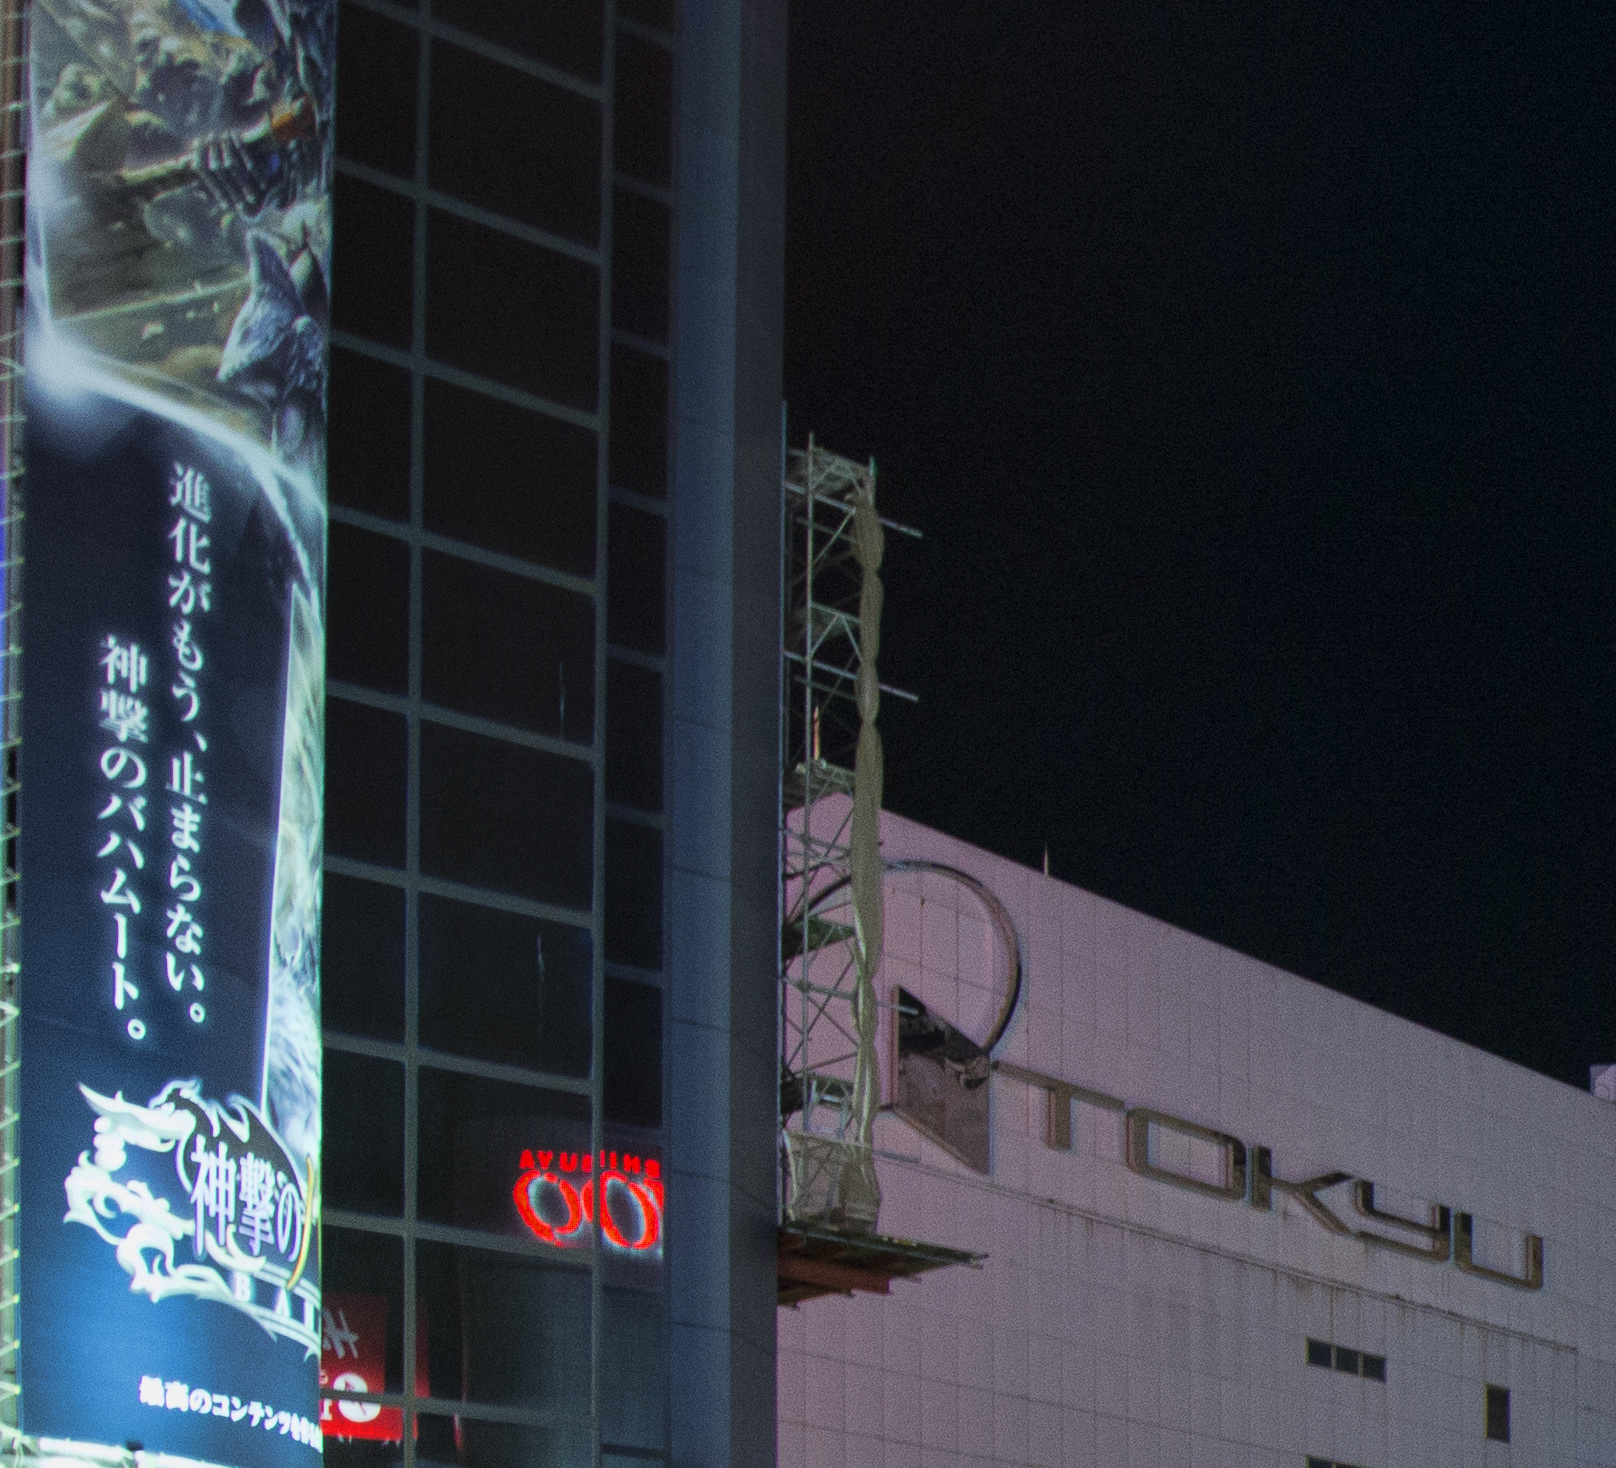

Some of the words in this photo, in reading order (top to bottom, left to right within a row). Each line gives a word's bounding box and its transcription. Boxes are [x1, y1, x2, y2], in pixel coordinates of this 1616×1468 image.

[98, 636, 148, 1040] 神撃のバハムート。
[164, 462, 212, 1024] 進化がもう、止まらない。
[993, 1059, 1543, 1292] TOKYU
